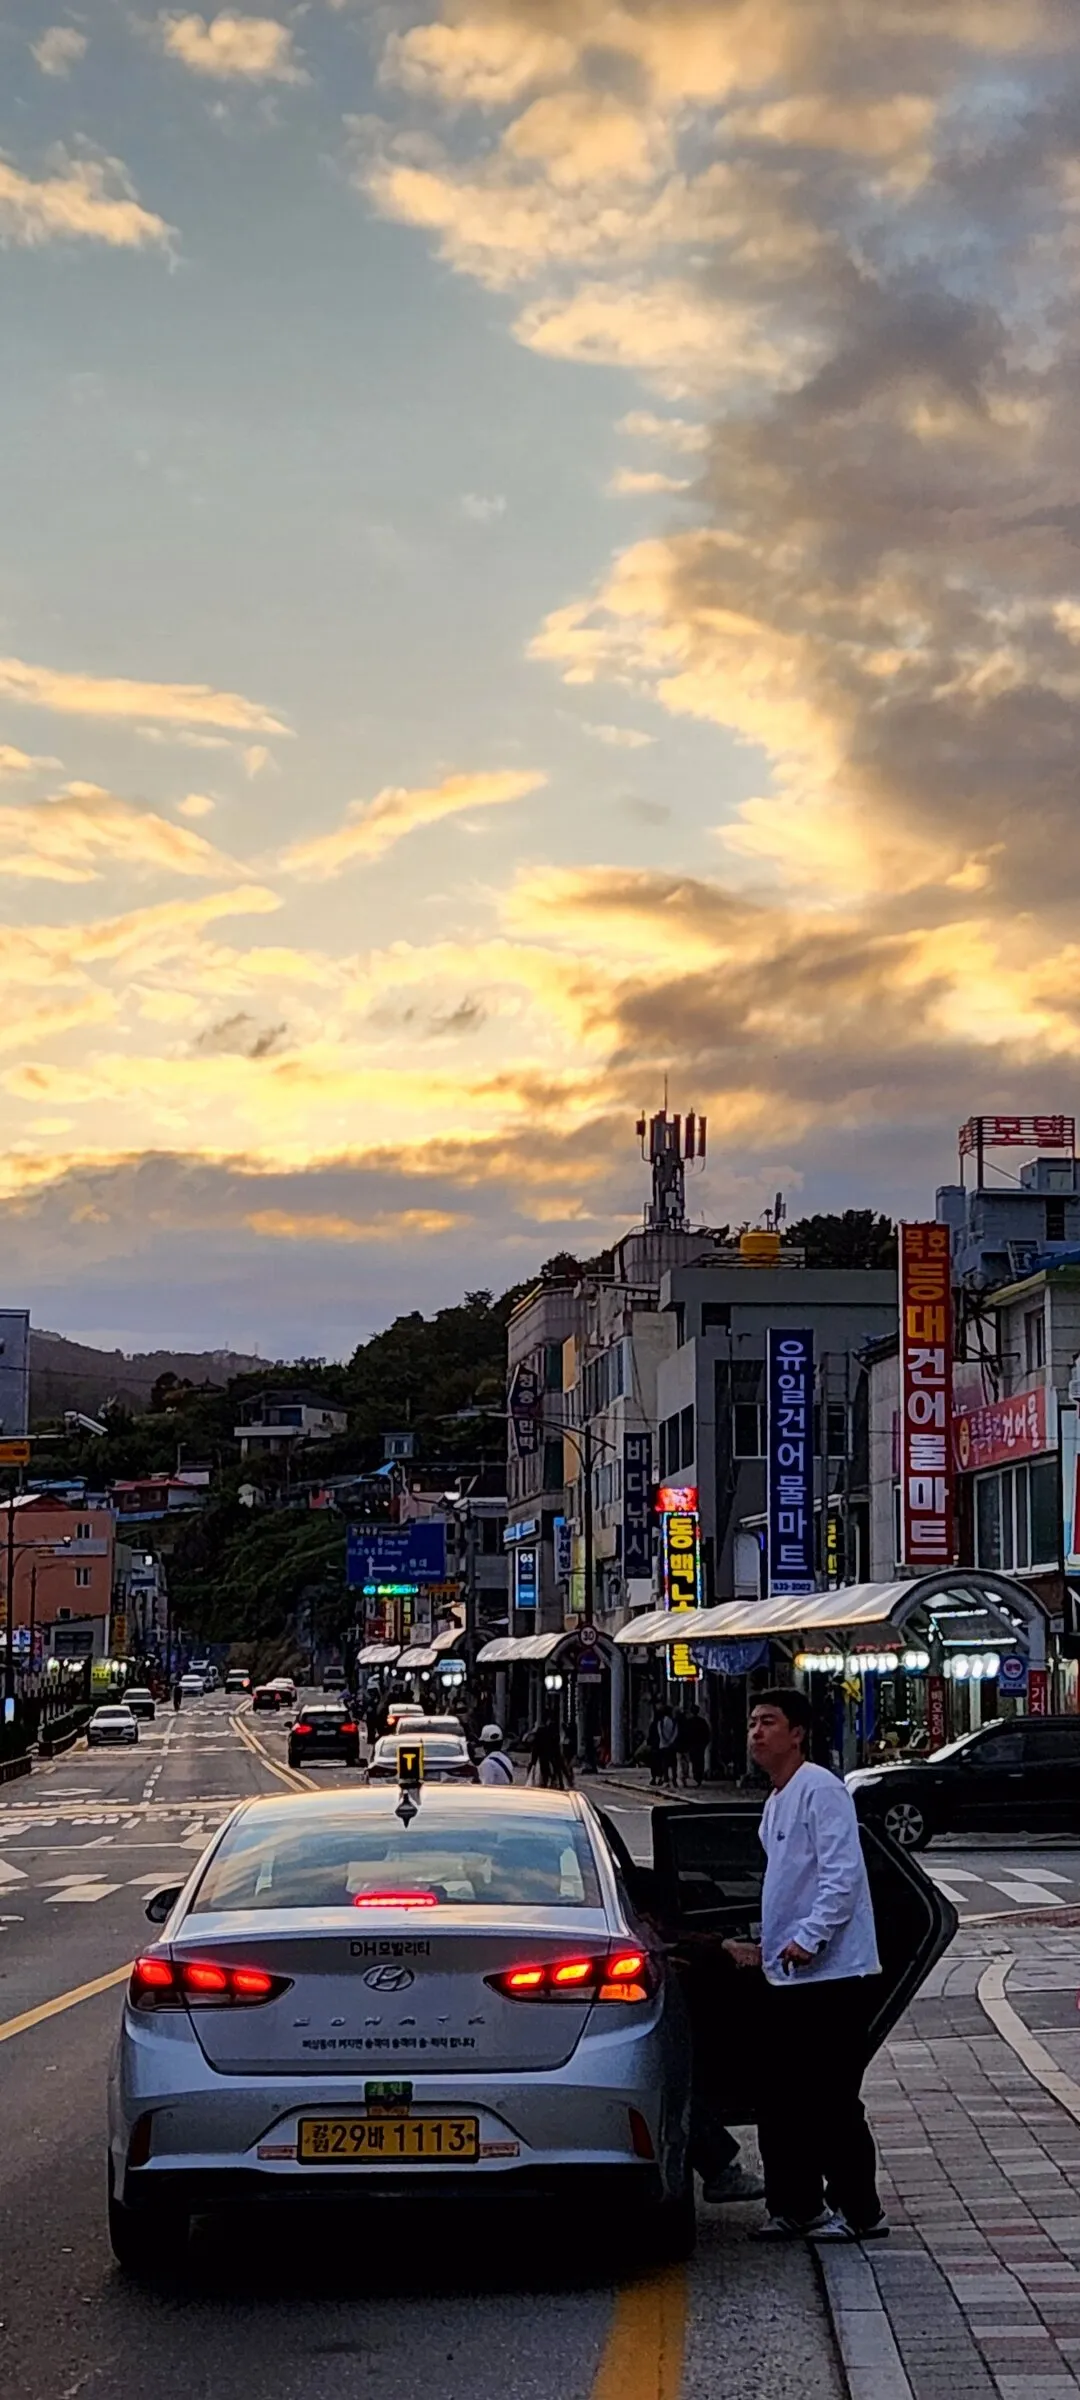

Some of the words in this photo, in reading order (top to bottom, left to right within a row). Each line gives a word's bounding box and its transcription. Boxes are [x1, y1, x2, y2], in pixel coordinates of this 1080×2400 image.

[905, 1229, 946, 1259] 묵호
[776, 1340, 808, 1571] 유일건어물마트
[626, 1438, 650, 1561] 바다낚시
[519, 1553, 534, 1563] GS
[582, 1630, 596, 1642] 30
[402, 1753, 417, 1771] T
[350, 1940, 431, 1957] DH모빌리티
[330, 2125, 384, 2153] 29바
[393, 2123, 466, 2152] 1113
